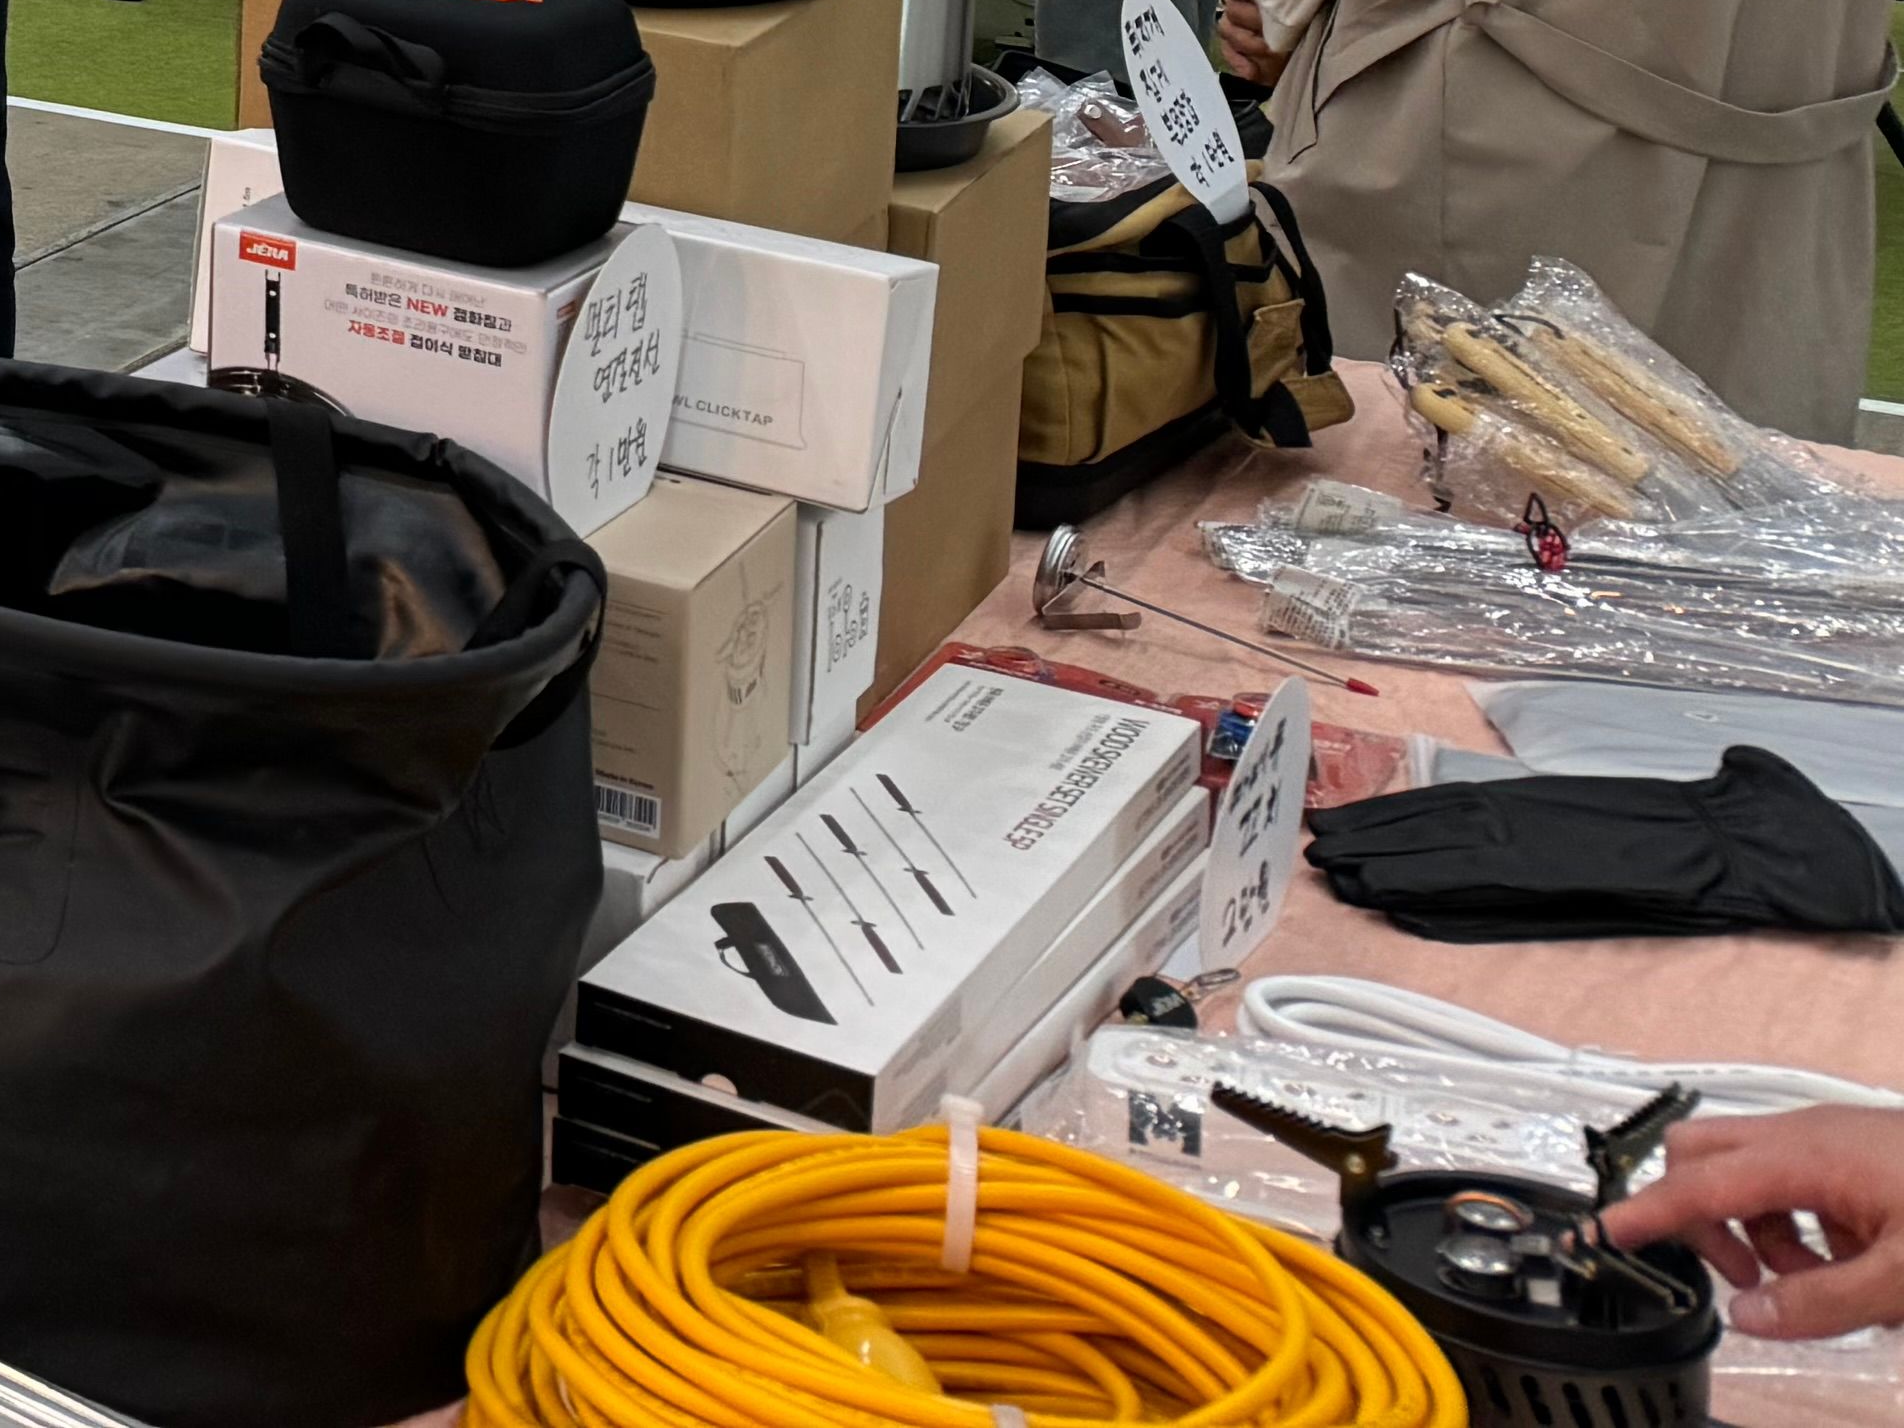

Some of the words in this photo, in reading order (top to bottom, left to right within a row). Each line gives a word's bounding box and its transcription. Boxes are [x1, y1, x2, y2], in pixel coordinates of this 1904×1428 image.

[345, 283, 402, 309] 특허받은
[406, 296, 449, 318] NEW
[347, 319, 406, 345] 자동조절
[409, 334, 453, 356] 접이식
[585, 289, 622, 357] 멀티
[695, 399, 743, 421] CLICK
[742, 410, 774, 427] TAP
[1099, 717, 1150, 750] WOOD
[1061, 747, 1122, 790] SKEWER
[1046, 785, 1086, 808] SET
